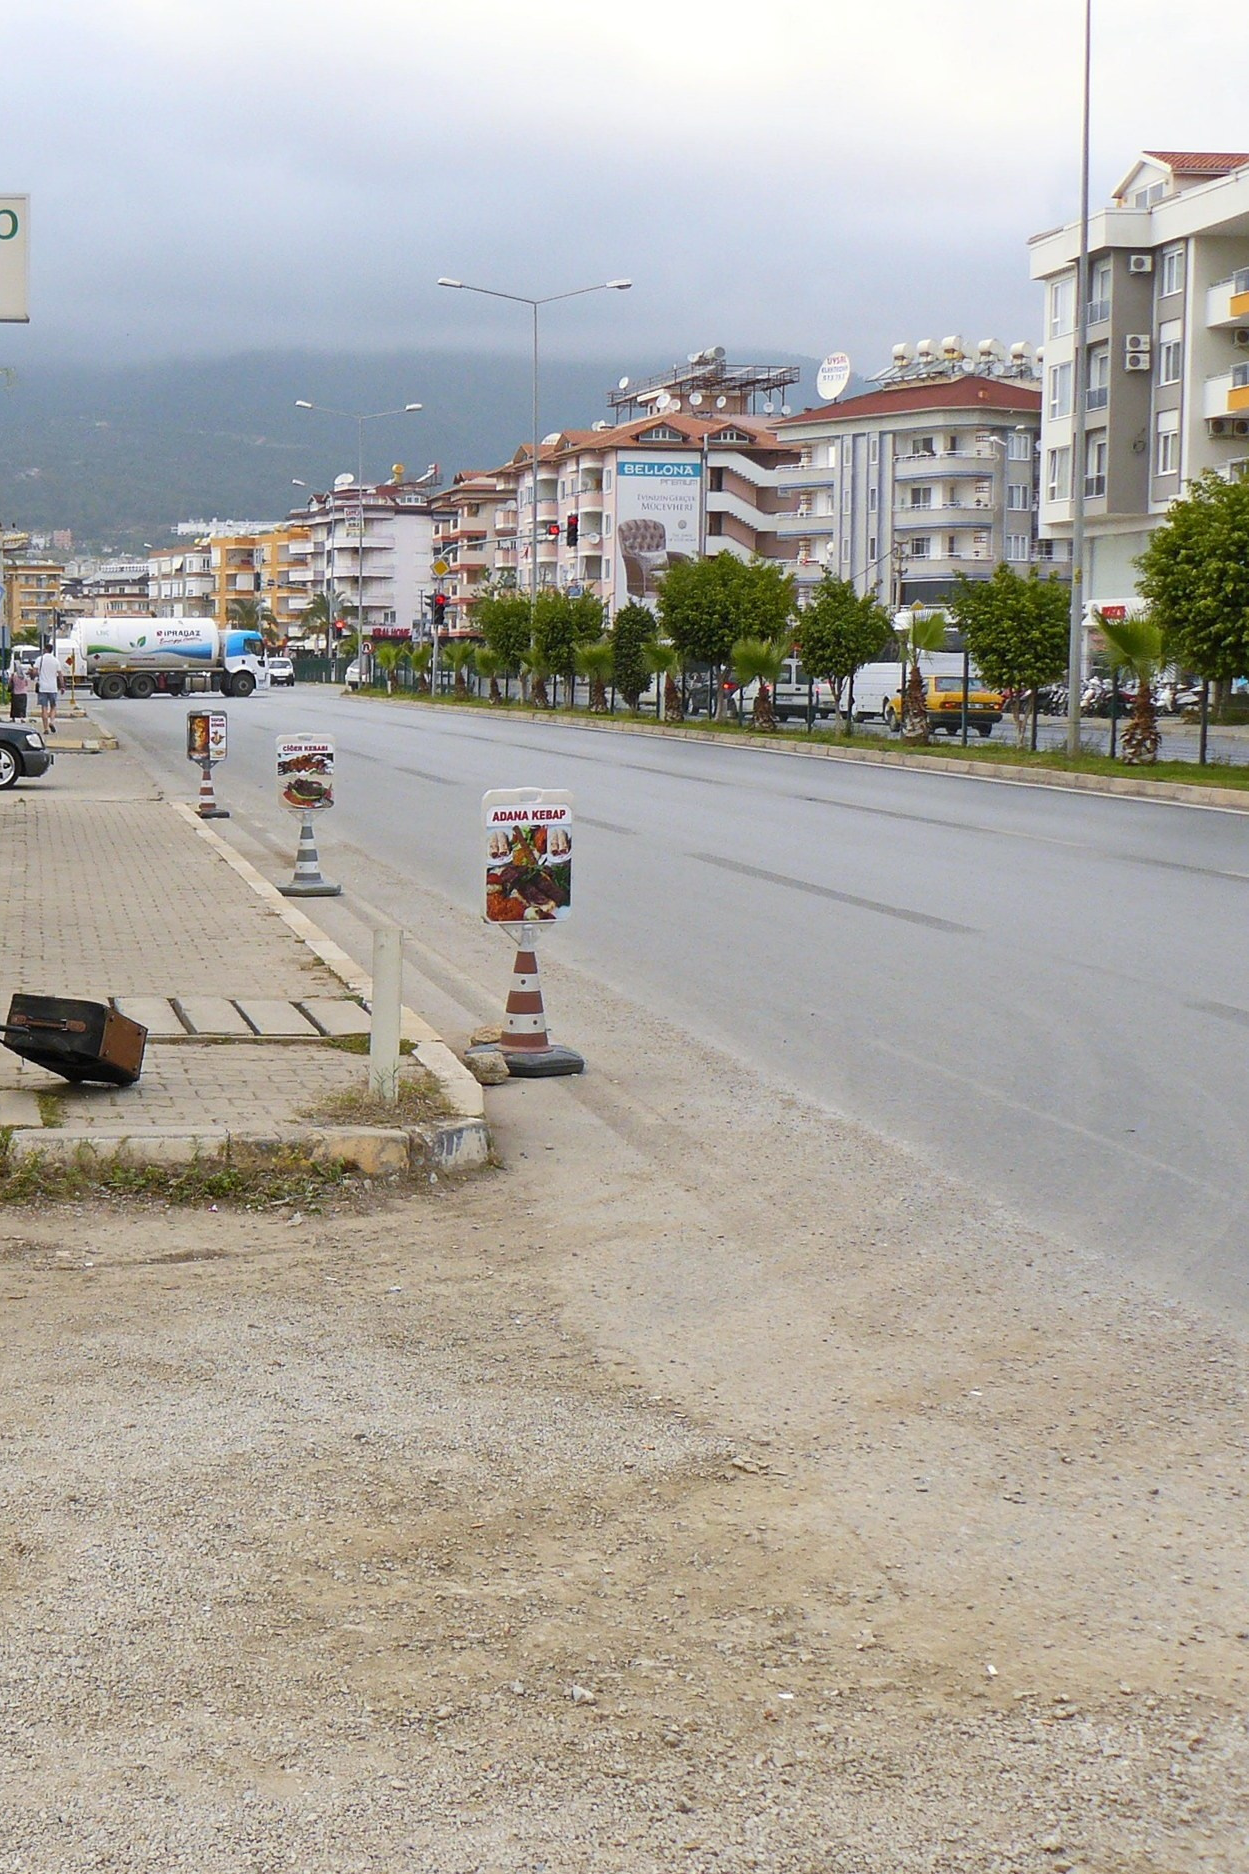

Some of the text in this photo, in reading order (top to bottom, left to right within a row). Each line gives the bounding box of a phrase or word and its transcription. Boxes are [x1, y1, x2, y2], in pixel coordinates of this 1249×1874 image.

[624, 464, 694, 475] BELLONA
[492, 810, 566, 822] ADANA KEBAP
